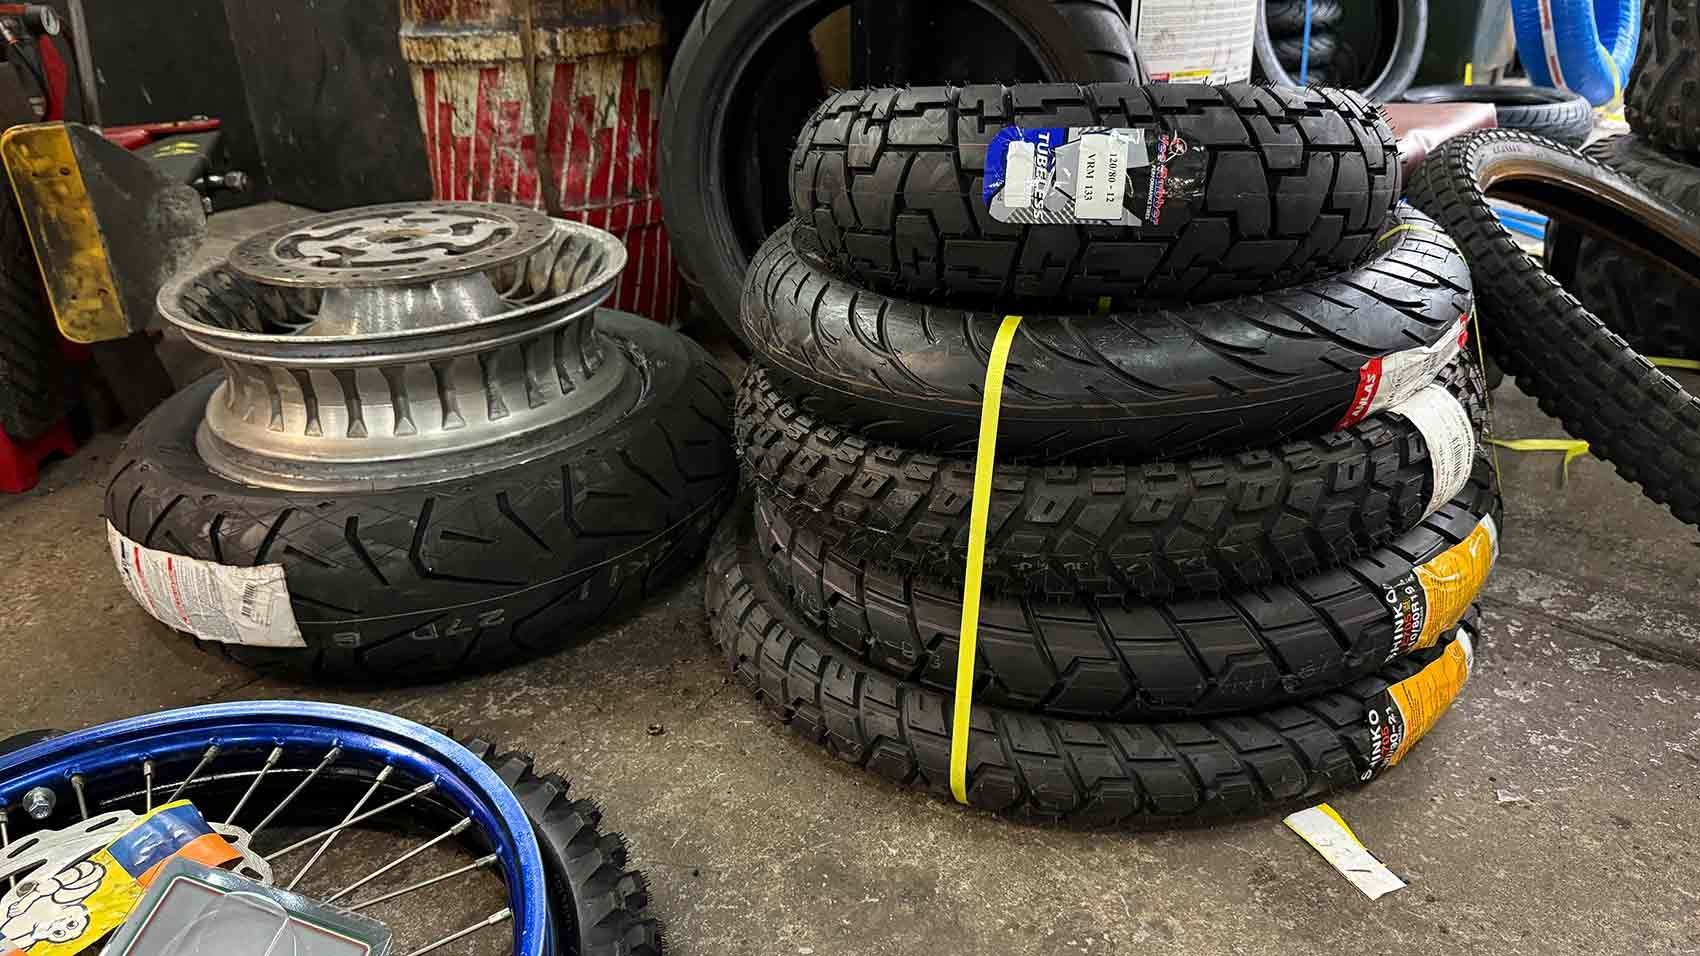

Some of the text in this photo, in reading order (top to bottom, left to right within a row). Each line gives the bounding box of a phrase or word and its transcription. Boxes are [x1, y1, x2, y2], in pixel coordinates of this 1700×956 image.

[1033, 132, 1050, 221] TUBELESS
[1083, 153, 1097, 201] VRM 133
[1106, 152, 1118, 183] 120/80
[1106, 192, 1116, 203] 12
